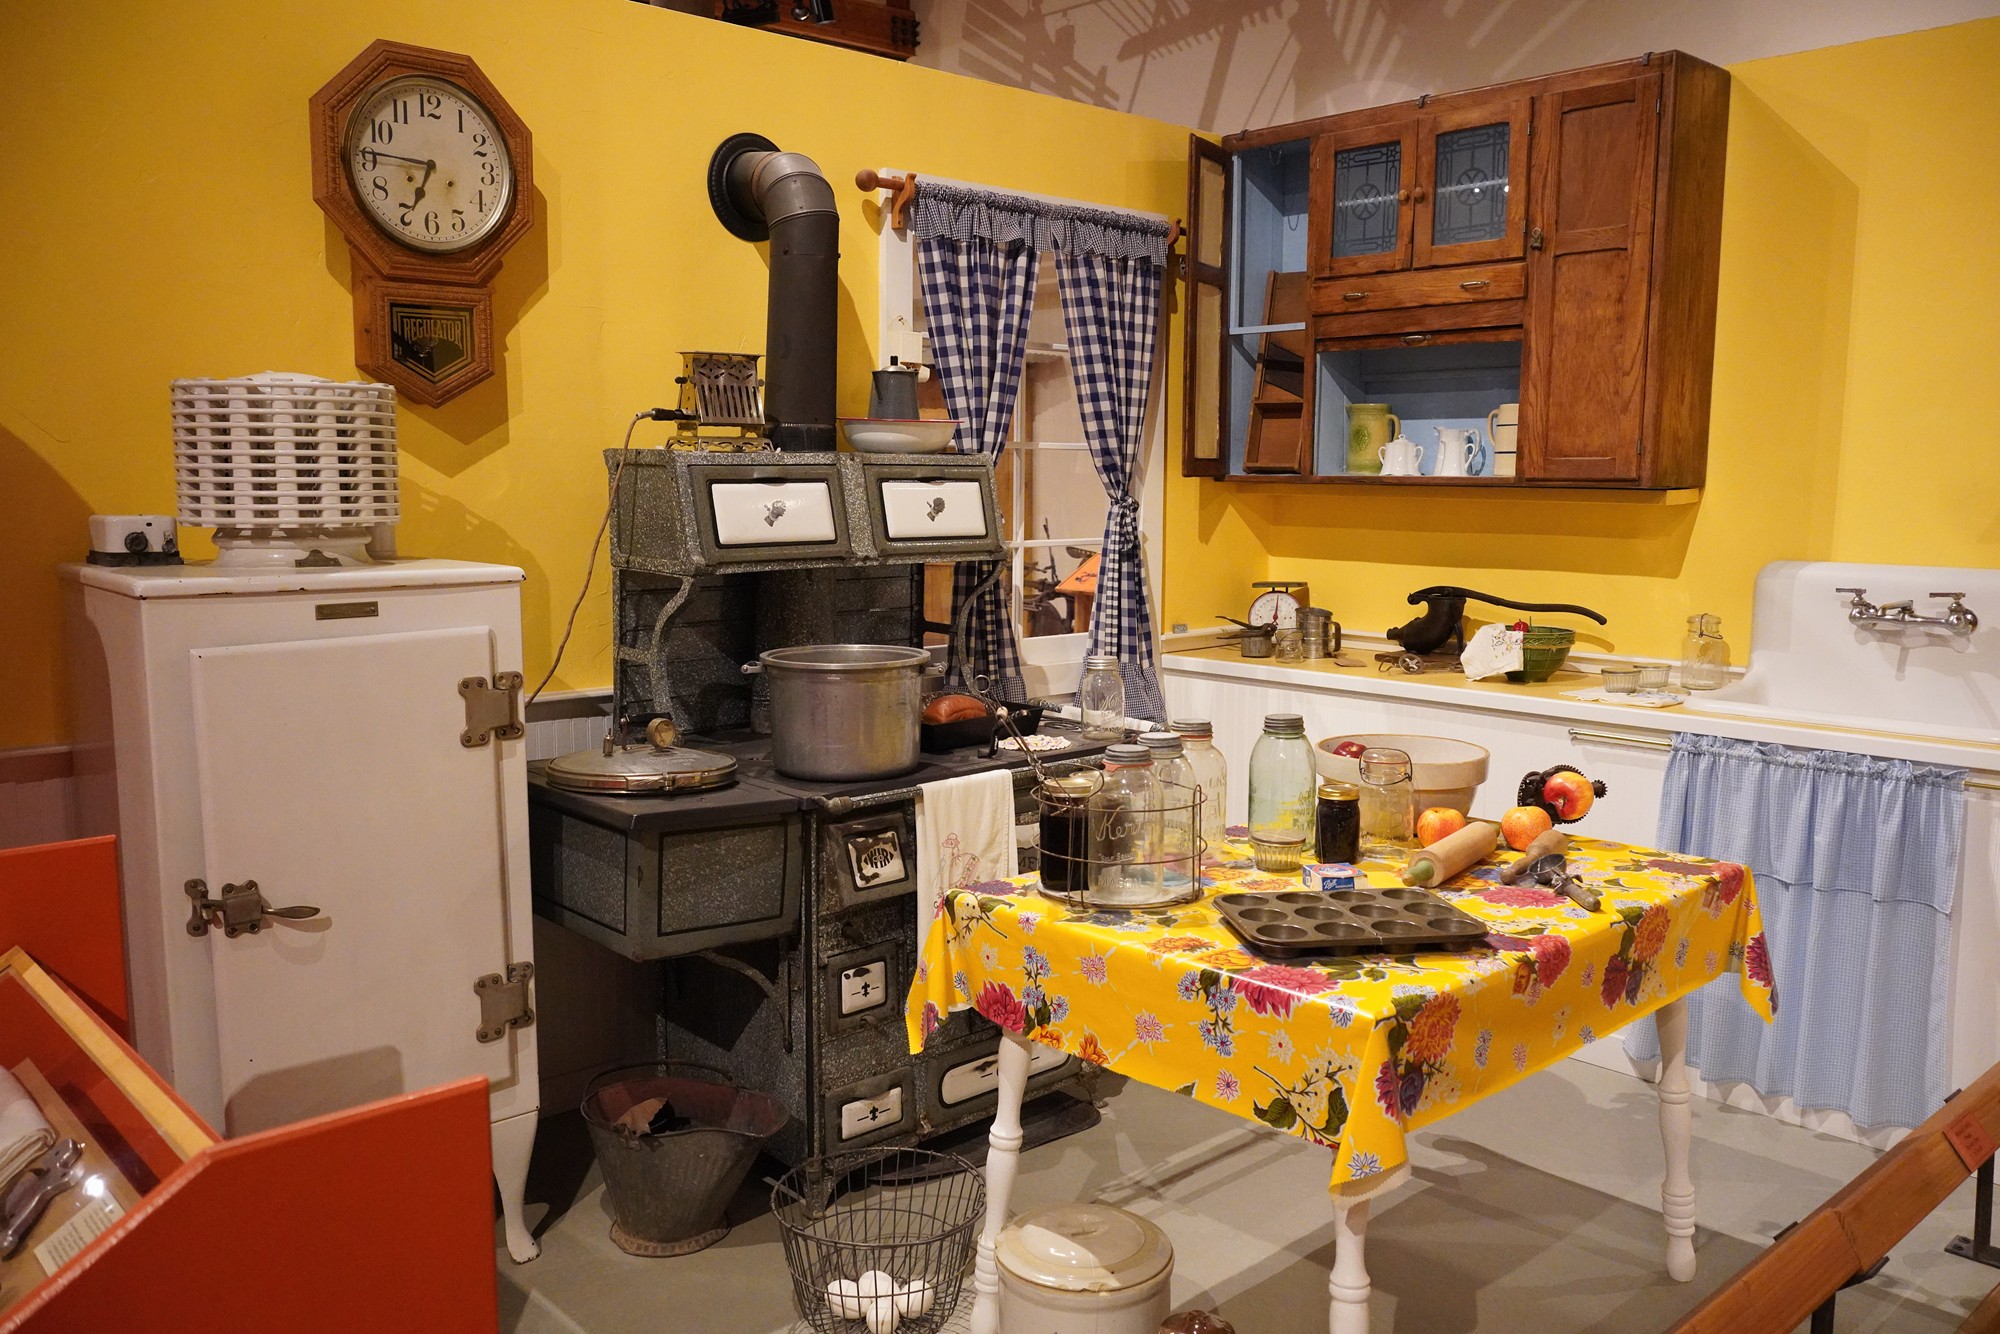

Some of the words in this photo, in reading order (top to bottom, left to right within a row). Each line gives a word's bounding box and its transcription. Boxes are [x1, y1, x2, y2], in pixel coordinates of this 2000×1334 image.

[392, 98, 409, 125] 11
[418, 92, 442, 120] 12
[370, 118, 393, 145] 10
[457, 109, 465, 134] 1
[472, 132, 488, 158] 2
[361, 146, 378, 172] 9
[480, 161, 495, 186] 3
[372, 175, 389, 201] 8
[469, 189, 487, 213] 4
[398, 201, 414, 226] 7
[424, 210, 440, 236] 6
[451, 209, 465, 233] 5
[403, 318, 463, 350] REGULATOR
